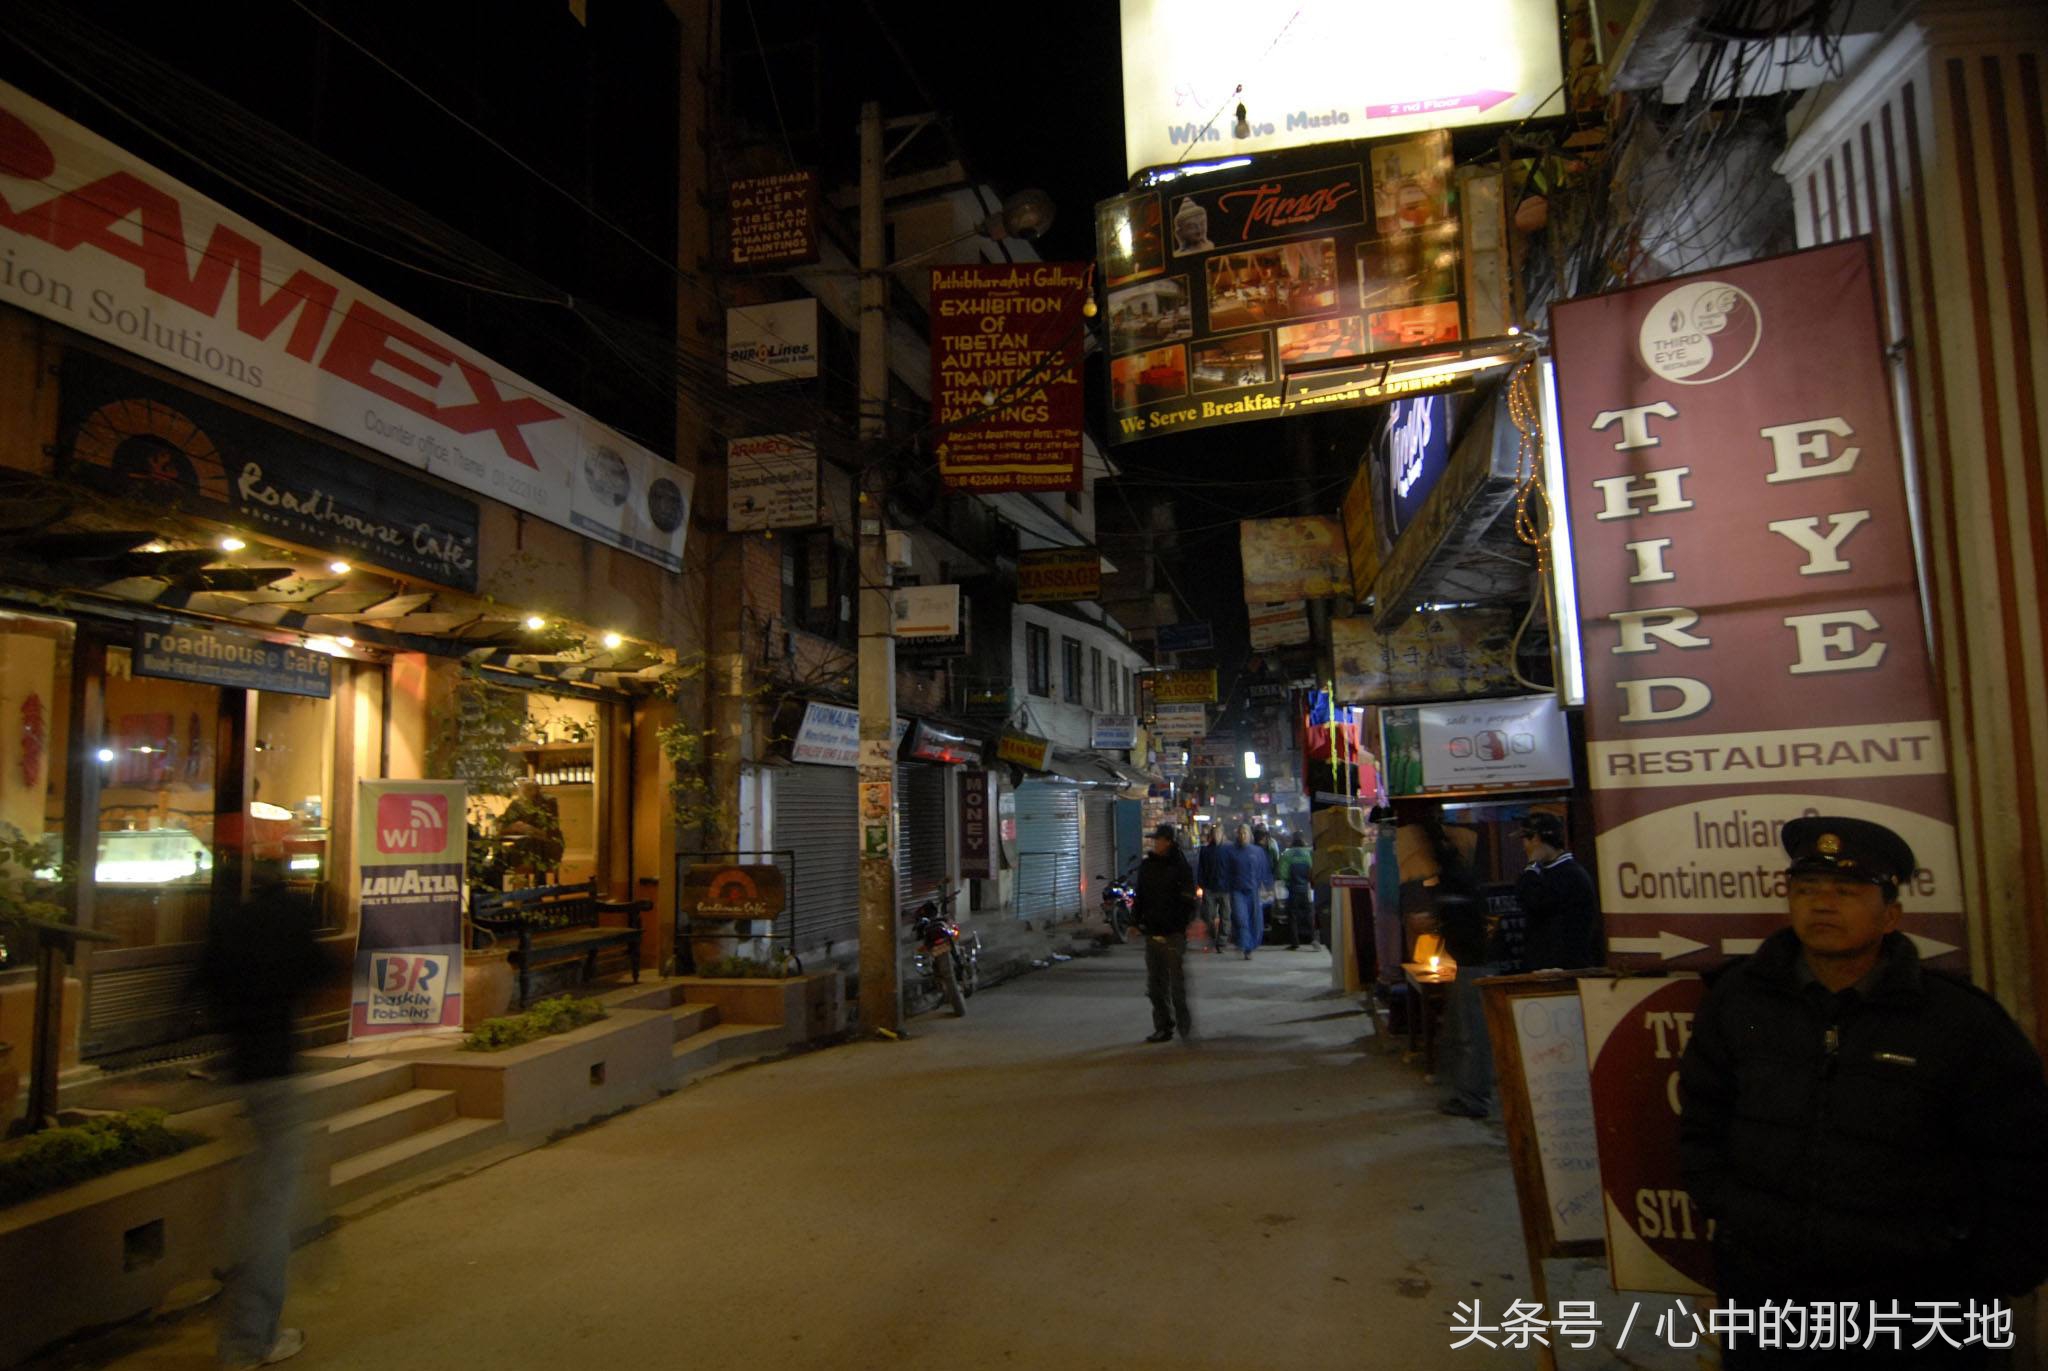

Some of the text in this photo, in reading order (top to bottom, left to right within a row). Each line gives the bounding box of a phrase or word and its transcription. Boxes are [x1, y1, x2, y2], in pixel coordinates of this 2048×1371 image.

[1389, 97, 1460, 114] 2 nd Floor
[1168, 109, 1350, 145] With Lve Music
[1218, 183, 1358, 240] Tamas
[939, 297, 1062, 317] EXHIBITION
[88, 289, 264, 388] Solutions
[941, 333, 1029, 351] TIBETAN
[1653, 334, 1702, 350] THIRD
[1654, 349, 1687, 363] EYE
[364, 409, 416, 447] Counter
[1120, 416, 1145, 434] We
[1150, 406, 1197, 428] Serve
[1201, 393, 1296, 418] Breakfas,
[237, 462, 404, 546] Roadhouse
[1591, 401, 1712, 723] THIRD
[1760, 416, 1888, 675] EYE
[1019, 566, 1099, 589] MASSAGE
[143, 631, 279, 668] roadhouse
[1154, 684, 1208, 697] CARGO
[1607, 736, 1932, 777] RESTAURANT
[966, 778, 983, 850] MONEY
[361, 869, 459, 896] LAVAZZA
[1618, 862, 1789, 900] Continenta
[373, 991, 432, 1007] baskin
